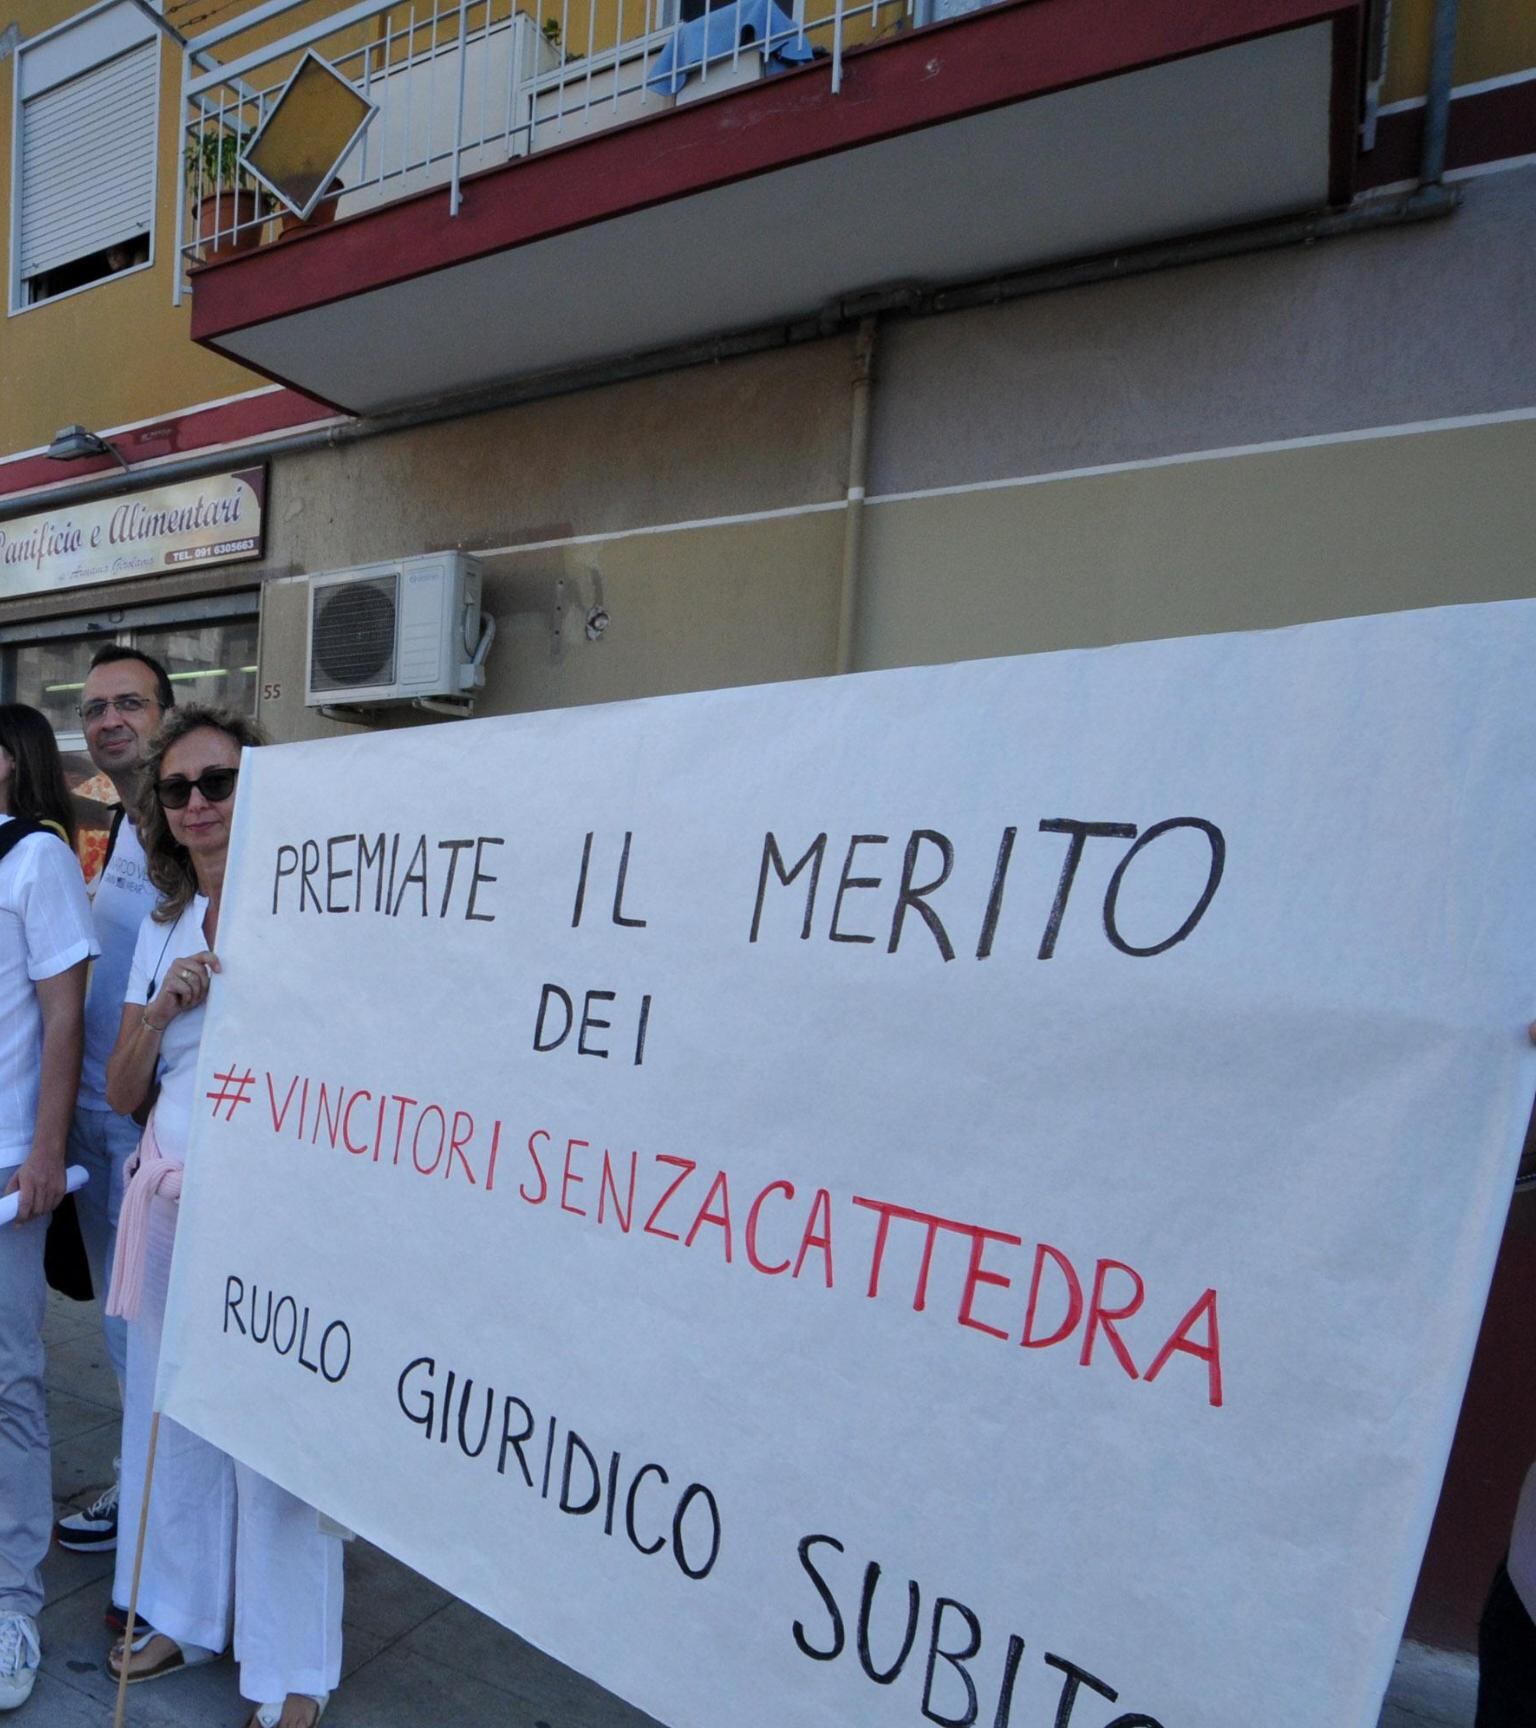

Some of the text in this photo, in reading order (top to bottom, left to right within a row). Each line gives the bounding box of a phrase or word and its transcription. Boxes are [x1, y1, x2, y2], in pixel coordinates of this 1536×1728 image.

[90, 525, 101, 548] e
[108, 486, 243, 546] Alimentari
[194, 546, 212, 558] 091
[271, 816, 1226, 962] PREMIATE IL MERITO
[533, 983, 653, 1066] DEI
[223, 1275, 1167, 1728] RUOLO GIURIDICO SUBIT
